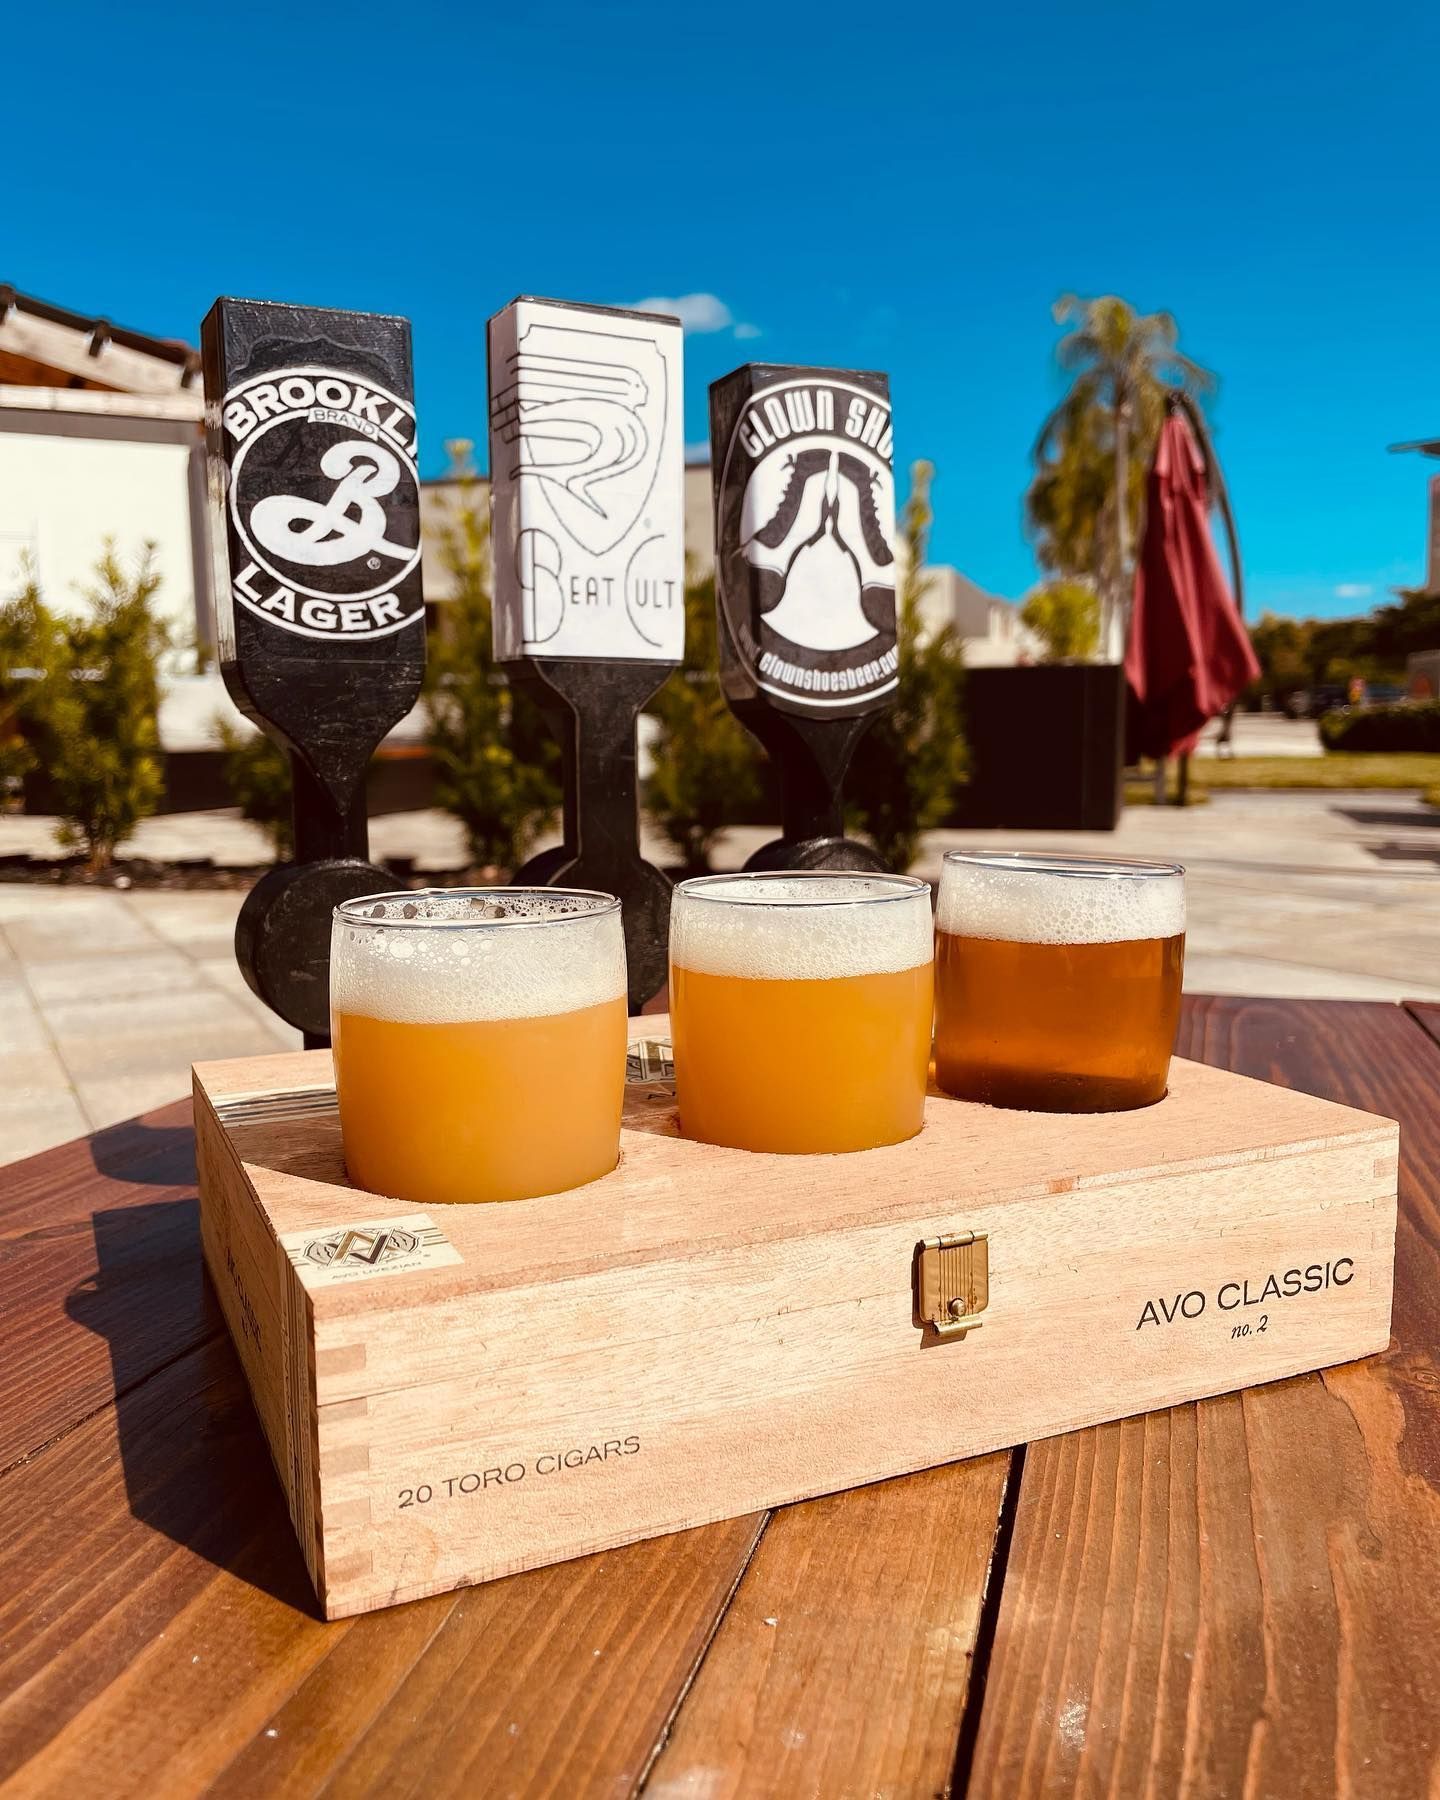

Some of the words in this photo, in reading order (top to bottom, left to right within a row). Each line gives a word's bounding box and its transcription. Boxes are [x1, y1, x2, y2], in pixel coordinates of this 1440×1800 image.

[223, 376, 417, 459] BROOKL
[313, 408, 376, 437] BRAND
[738, 389, 835, 458] CLOWN
[234, 562, 405, 631] LAGER
[757, 645, 898, 692] clownshoesbeer.co
[1136, 1290, 1206, 1330] AVO
[1217, 1257, 1355, 1311] CLASSIC
[1231, 1322, 1253, 1340] no.
[1256, 1314, 1269, 1333] 2
[398, 1484, 433, 1509] 20
[441, 1462, 526, 1498] TORO
[535, 1435, 641, 1476] CIGARS
